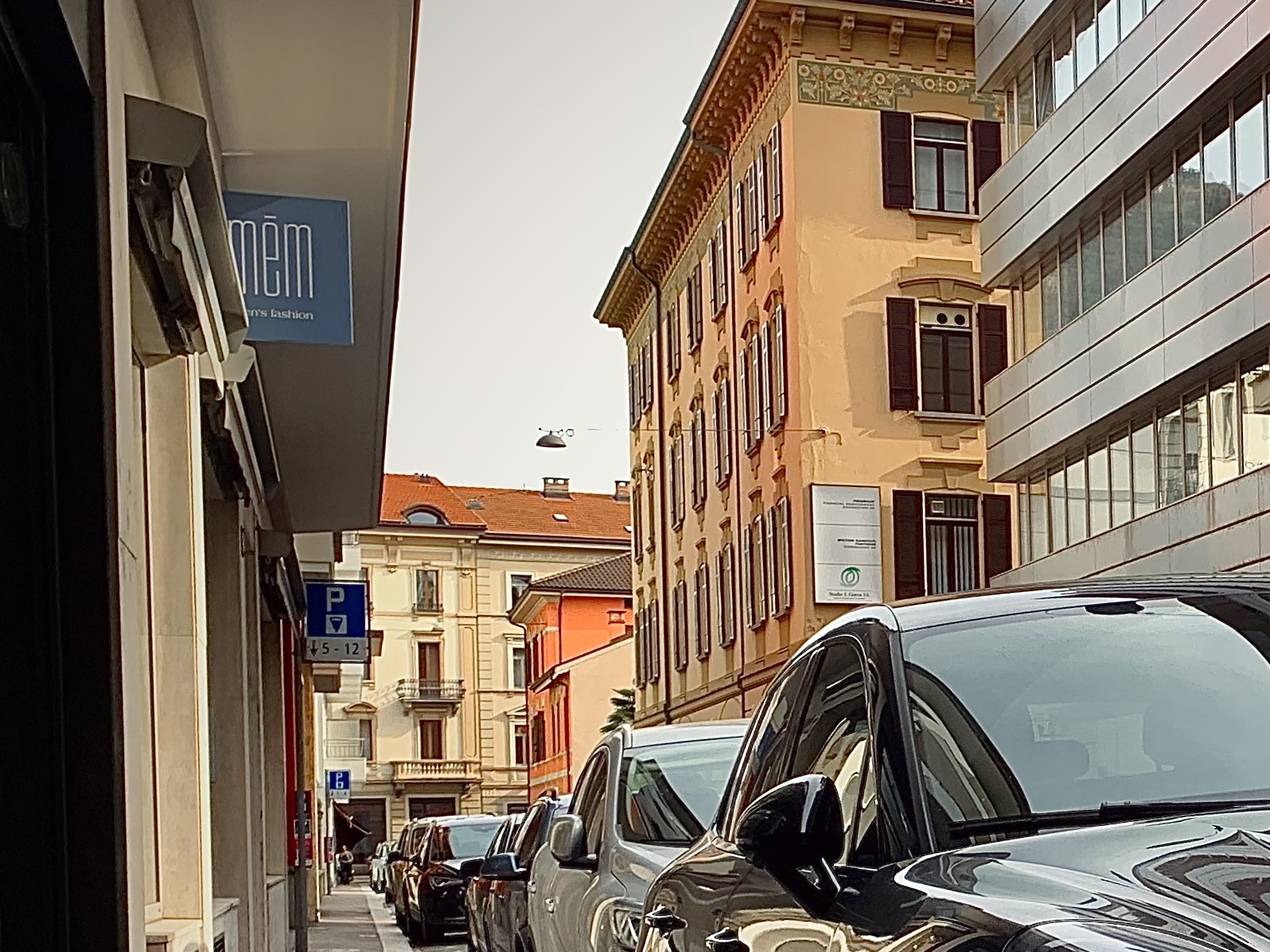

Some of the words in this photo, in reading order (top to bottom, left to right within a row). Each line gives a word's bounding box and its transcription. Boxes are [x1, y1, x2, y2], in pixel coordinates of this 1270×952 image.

[270, 308, 314, 321] fashion
[326, 586, 345, 612] P
[321, 642, 330, 655] 5
[344, 642, 359, 655] 12
